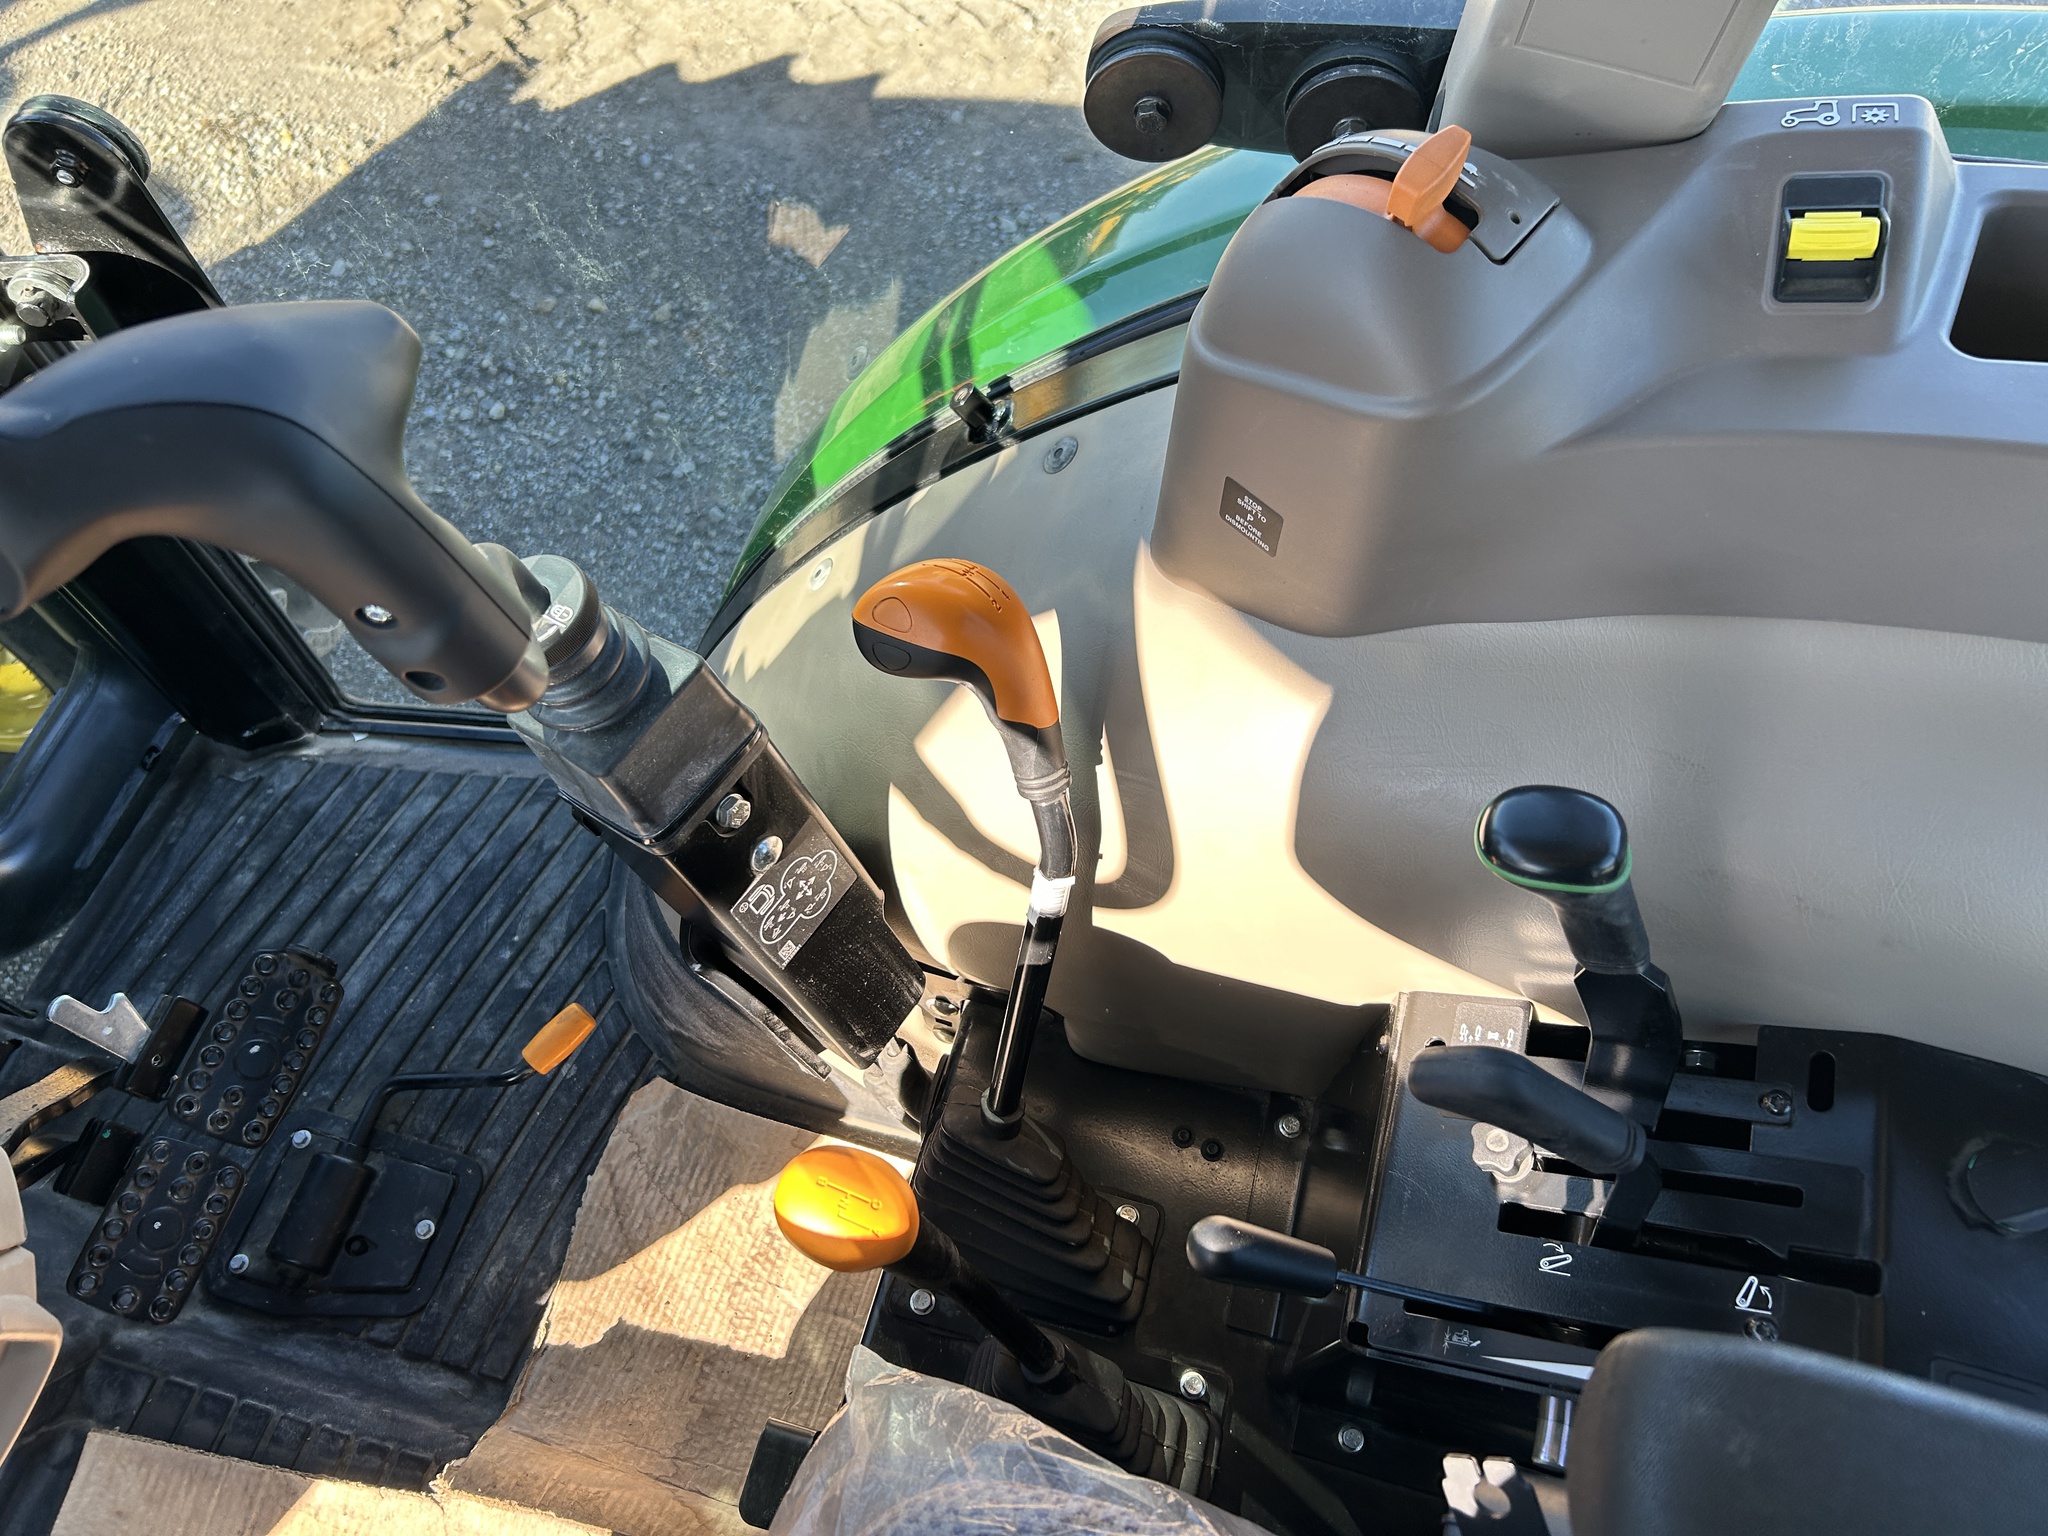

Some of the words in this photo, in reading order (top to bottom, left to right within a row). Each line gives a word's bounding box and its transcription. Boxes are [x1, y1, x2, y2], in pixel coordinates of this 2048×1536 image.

[1237, 497, 1256, 515] SHIFT
[1257, 512, 1267, 523] TO
[1244, 495, 1263, 512] STOP
[1235, 515, 1262, 538] BEFORE
[1246, 513, 1254, 521] P
[1225, 514, 1270, 552] DISMOUNTING
[991, 599, 1002, 613] 2
